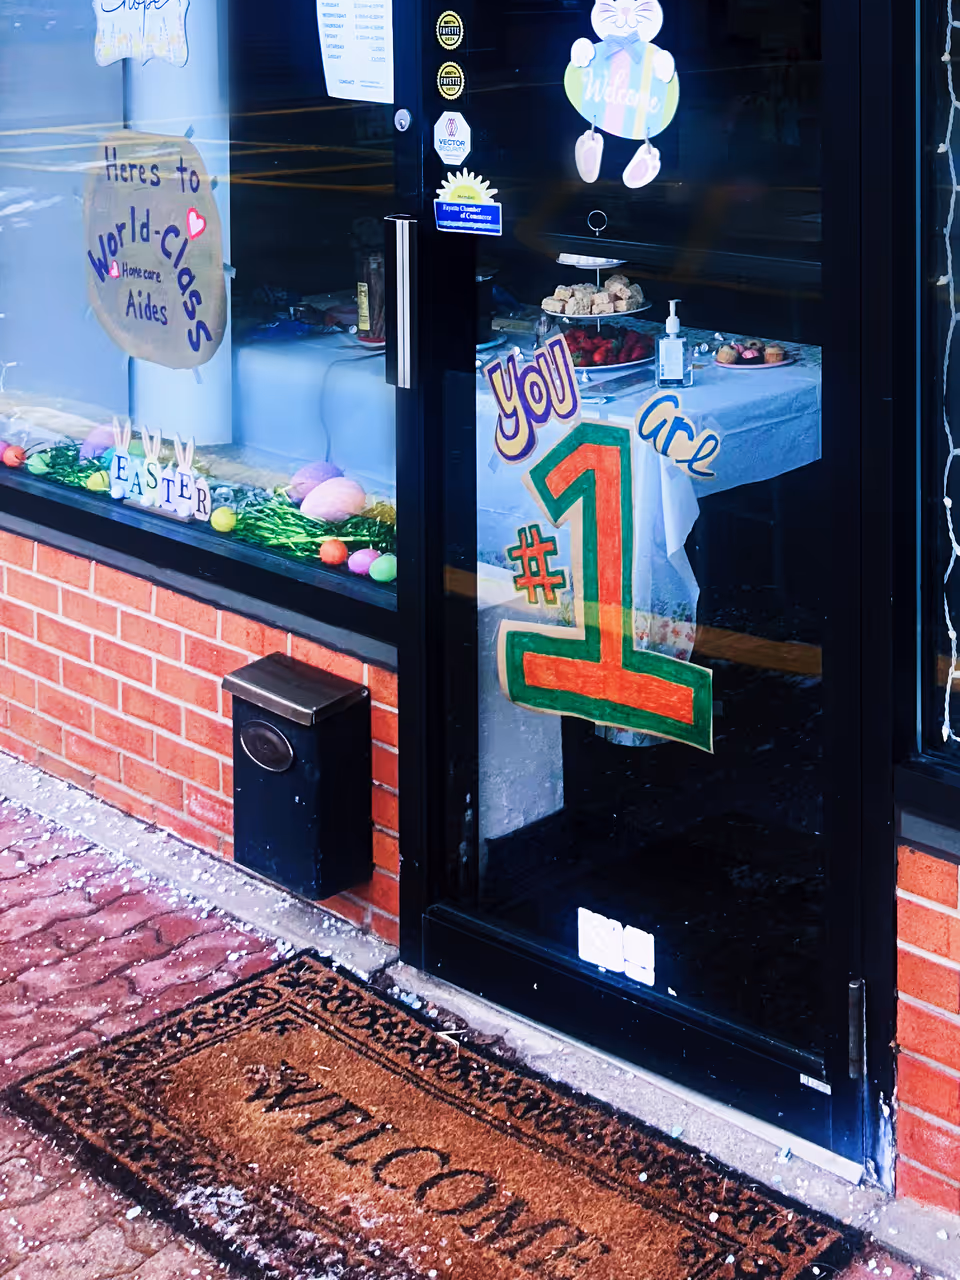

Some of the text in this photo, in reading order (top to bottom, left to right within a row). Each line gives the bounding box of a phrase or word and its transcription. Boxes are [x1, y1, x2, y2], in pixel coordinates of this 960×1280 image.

[439, 26, 460, 36] FAYETTE
[440, 77, 461, 86] FAYETTE
[438, 138, 466, 147] VECTOR
[176, 156, 200, 194] to
[125, 288, 168, 326] Aides
[114, 454, 209, 516] EASTER
